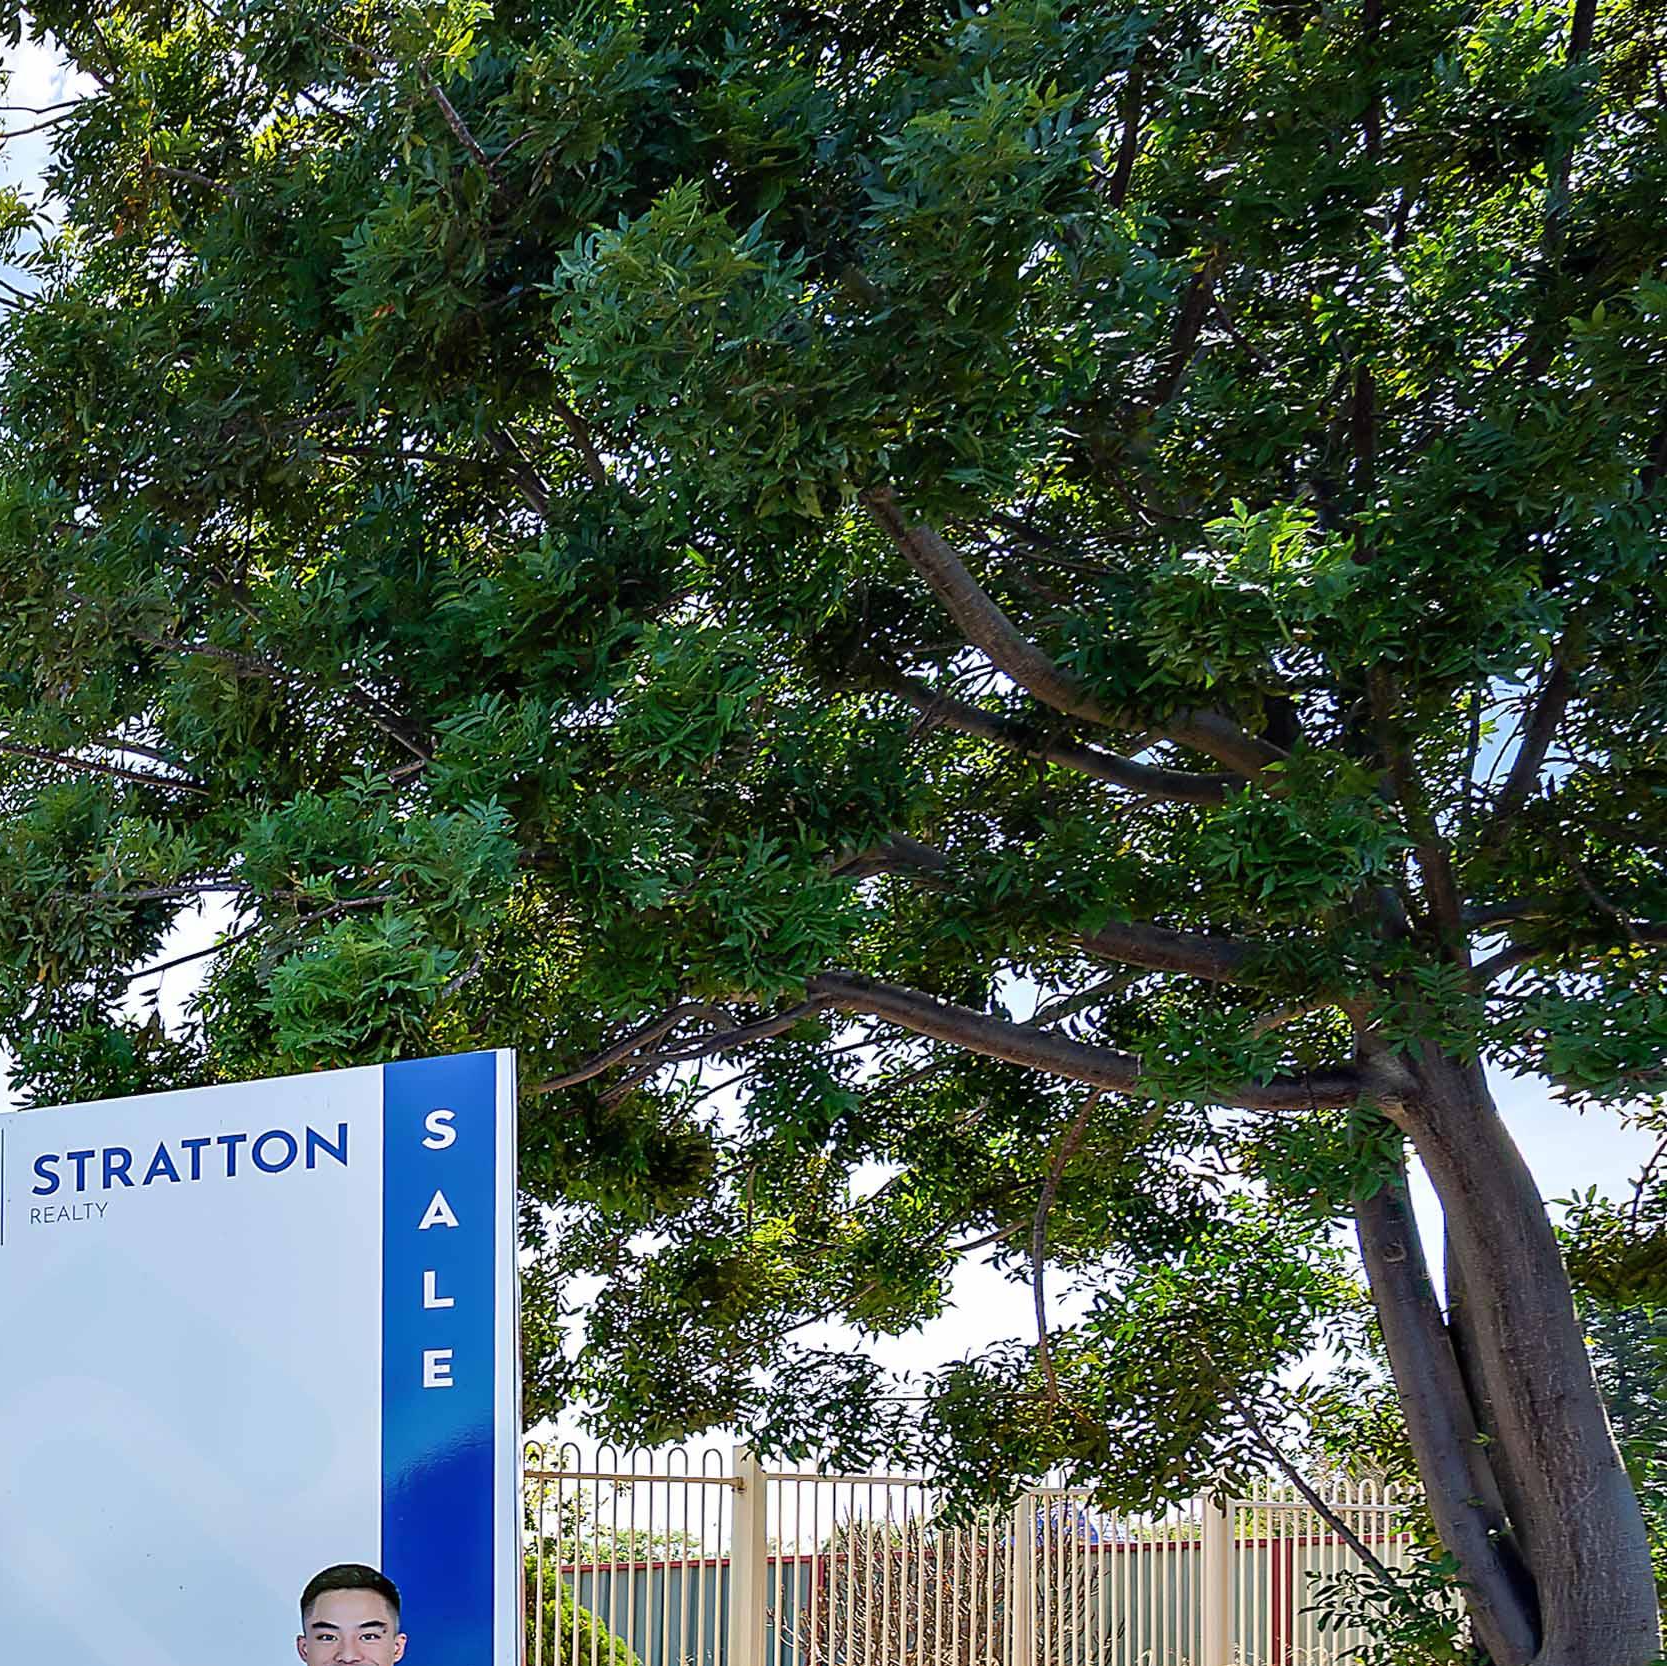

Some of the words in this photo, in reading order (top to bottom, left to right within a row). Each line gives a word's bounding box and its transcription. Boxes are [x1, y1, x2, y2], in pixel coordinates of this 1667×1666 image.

[31, 1122, 349, 1197] STRATTON
[29, 1201, 109, 1225] REALTY
[418, 1109, 460, 1388] SALE
